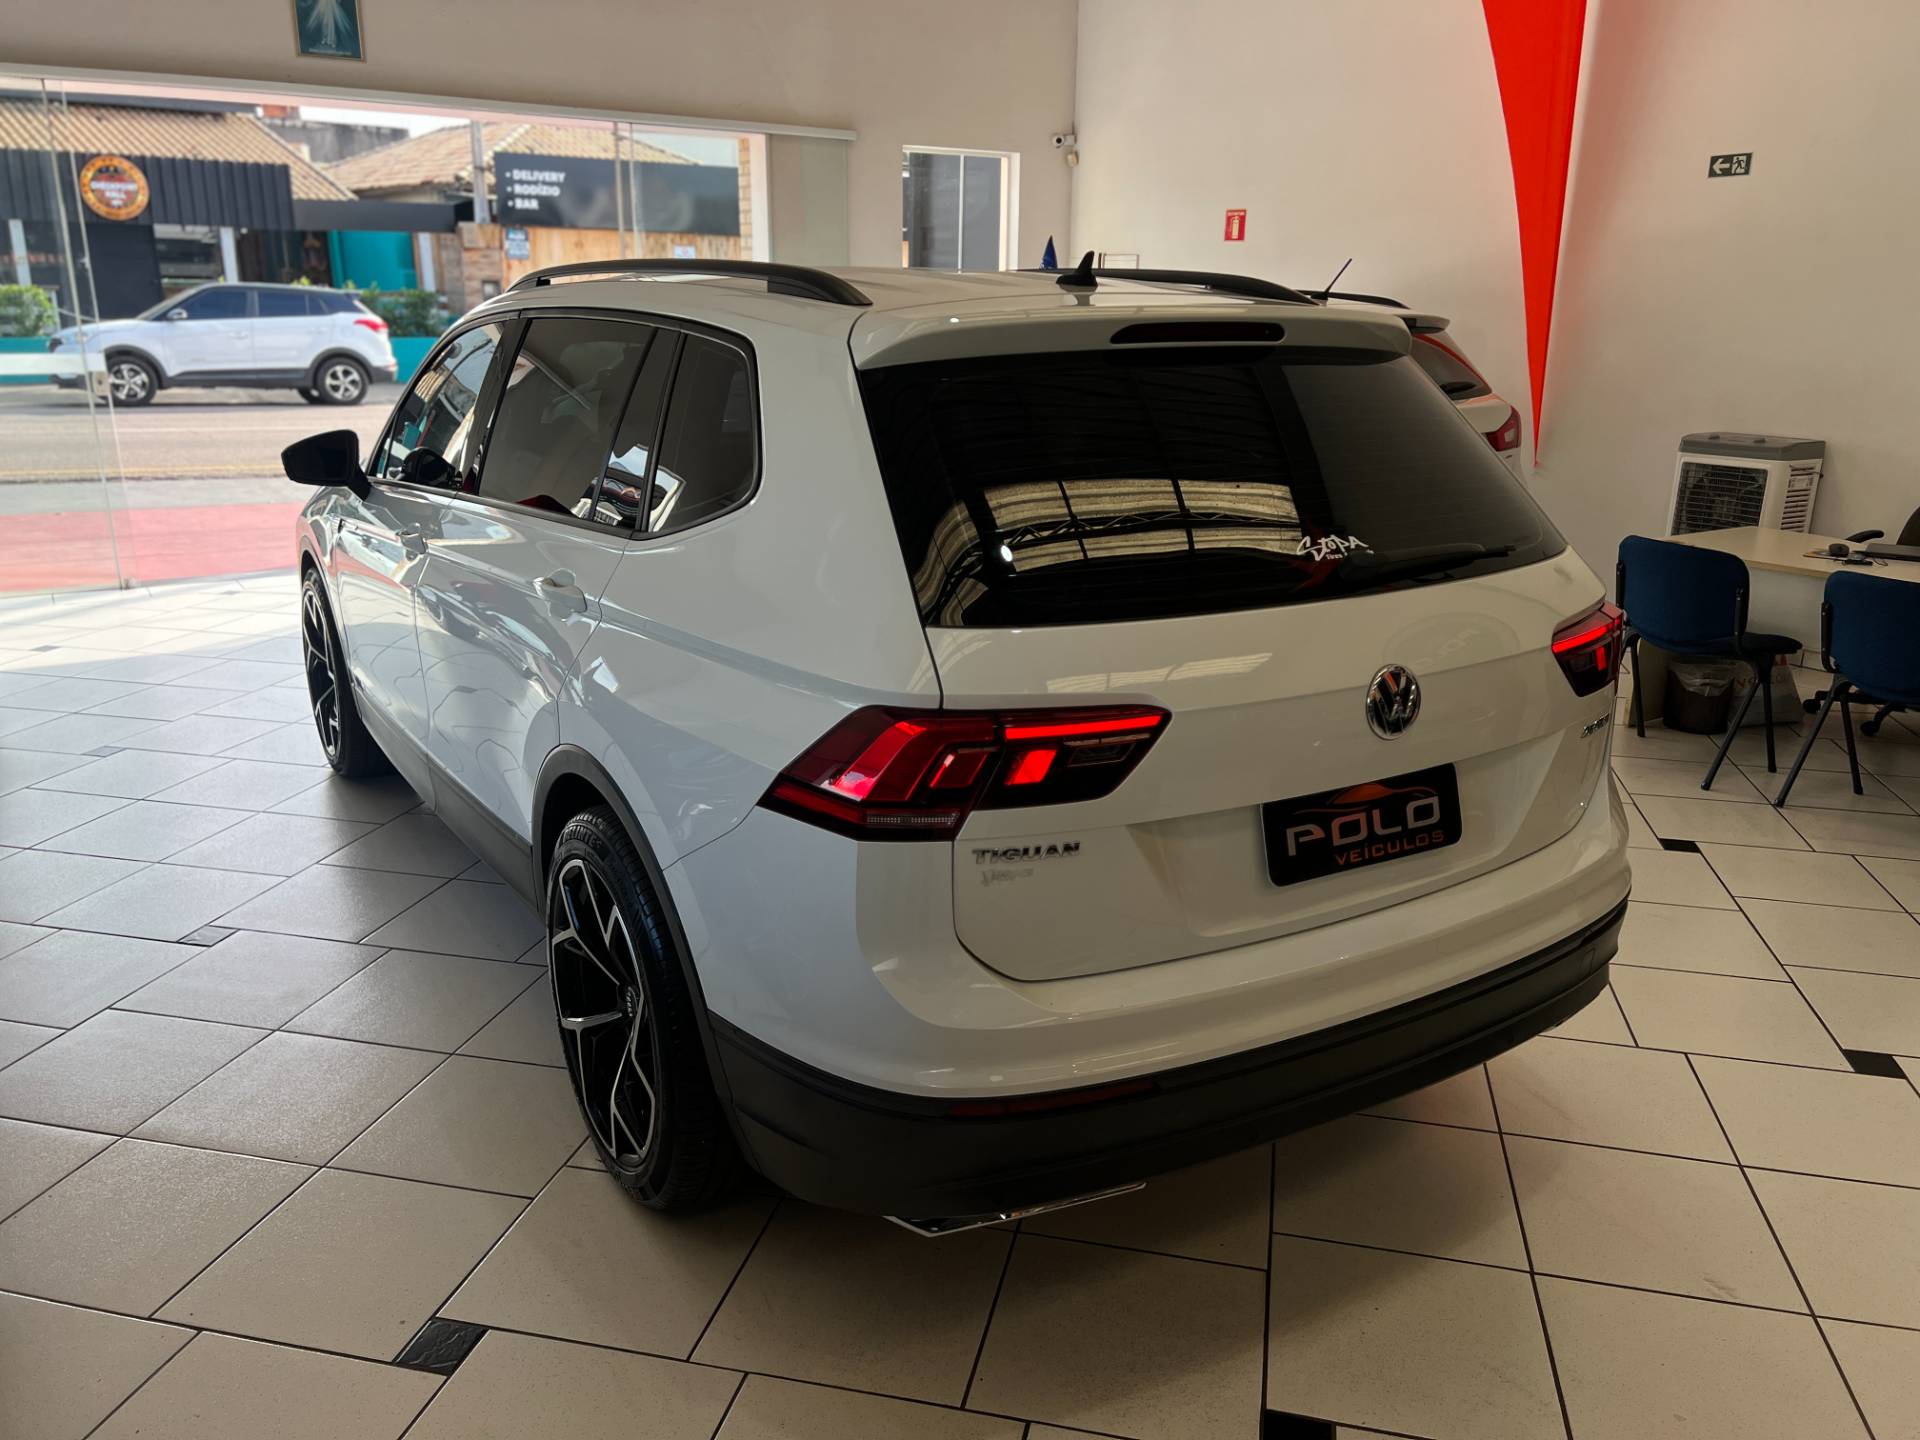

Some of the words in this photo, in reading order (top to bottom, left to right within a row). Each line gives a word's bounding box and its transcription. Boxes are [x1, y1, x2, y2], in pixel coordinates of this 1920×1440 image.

[512, 168, 565, 183] DELIVERY
[515, 197, 538, 210] BAR
[1286, 796, 1440, 856] POLO
[971, 842, 1081, 865] TIGUAN
[1334, 830, 1445, 866] VEÍCULOS
